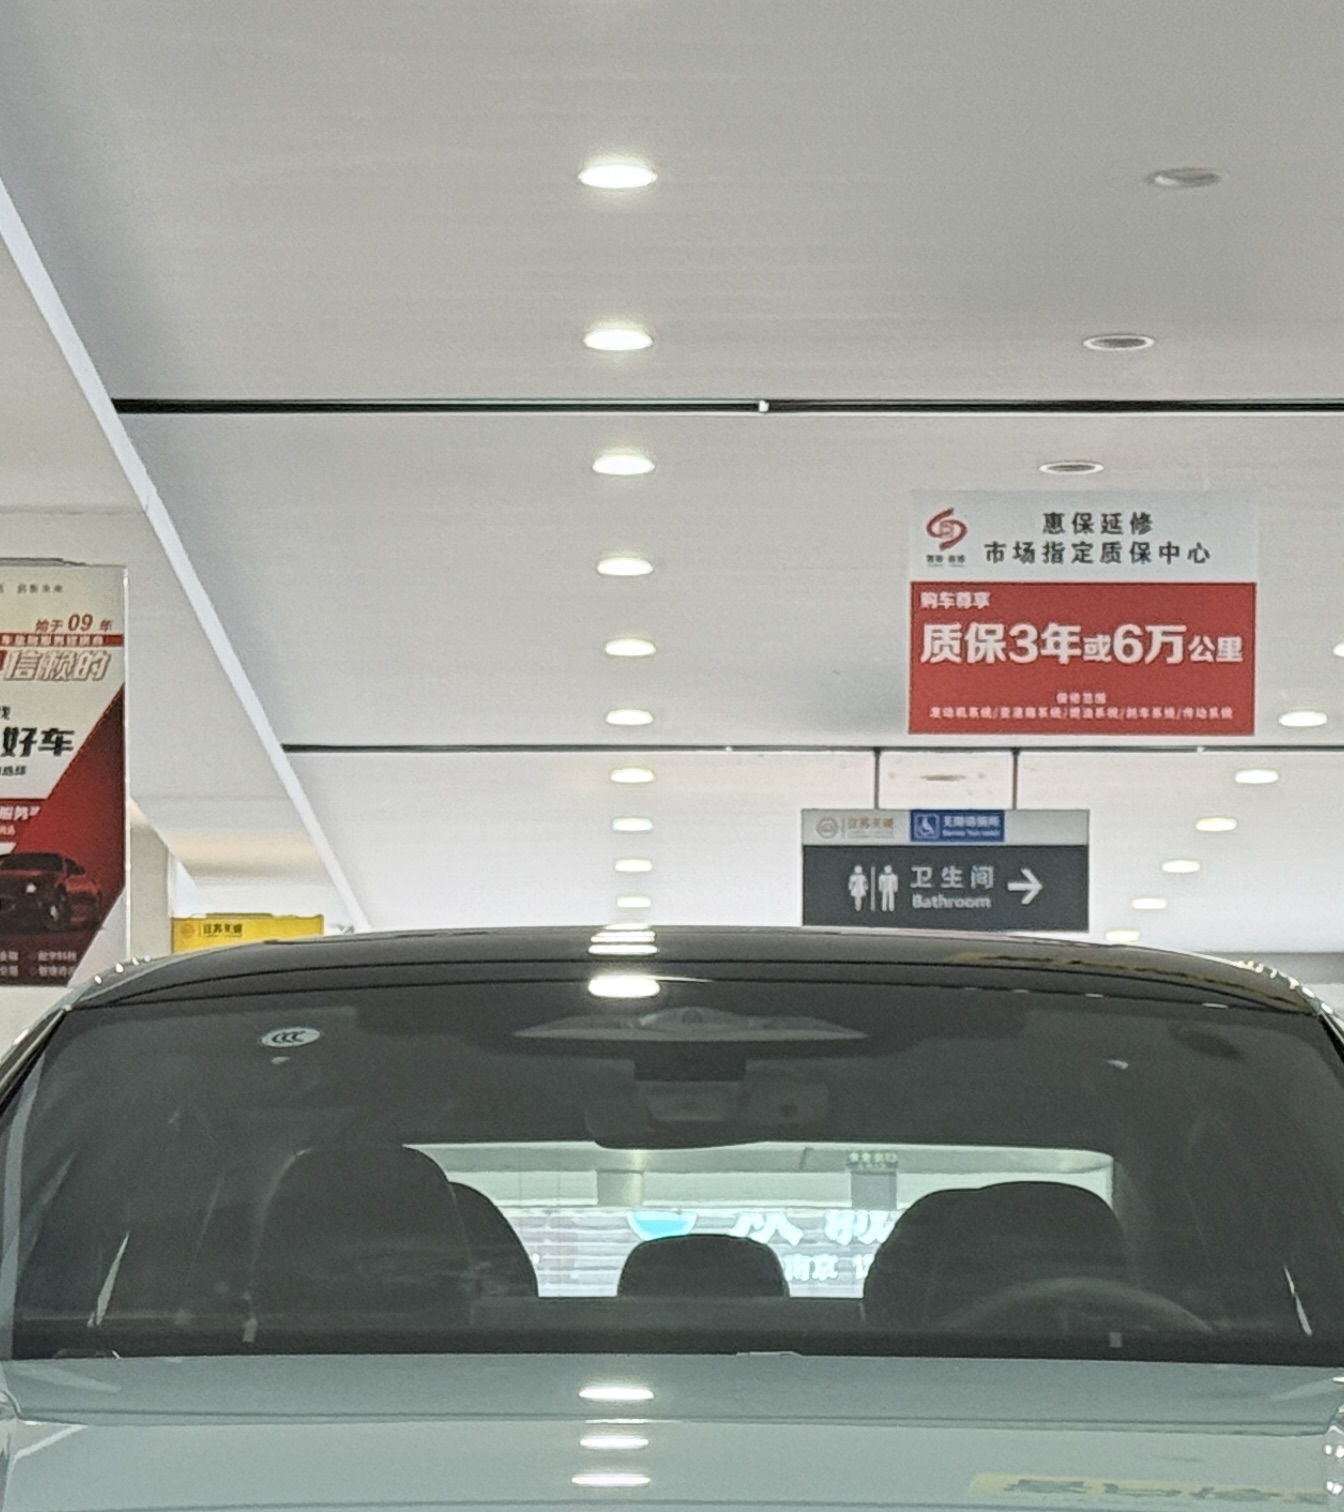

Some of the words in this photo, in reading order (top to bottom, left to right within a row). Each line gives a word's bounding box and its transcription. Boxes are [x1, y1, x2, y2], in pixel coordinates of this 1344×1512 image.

[1042, 511, 1154, 535] 惠保延修
[984, 541, 1211, 565] 市场指定质保中心
[68, 613, 93, 631] 09
[920, 622, 1243, 665] 质保3年或6万公里
[911, 865, 994, 889] 卫生间
[912, 893, 992, 908] Bathroom
